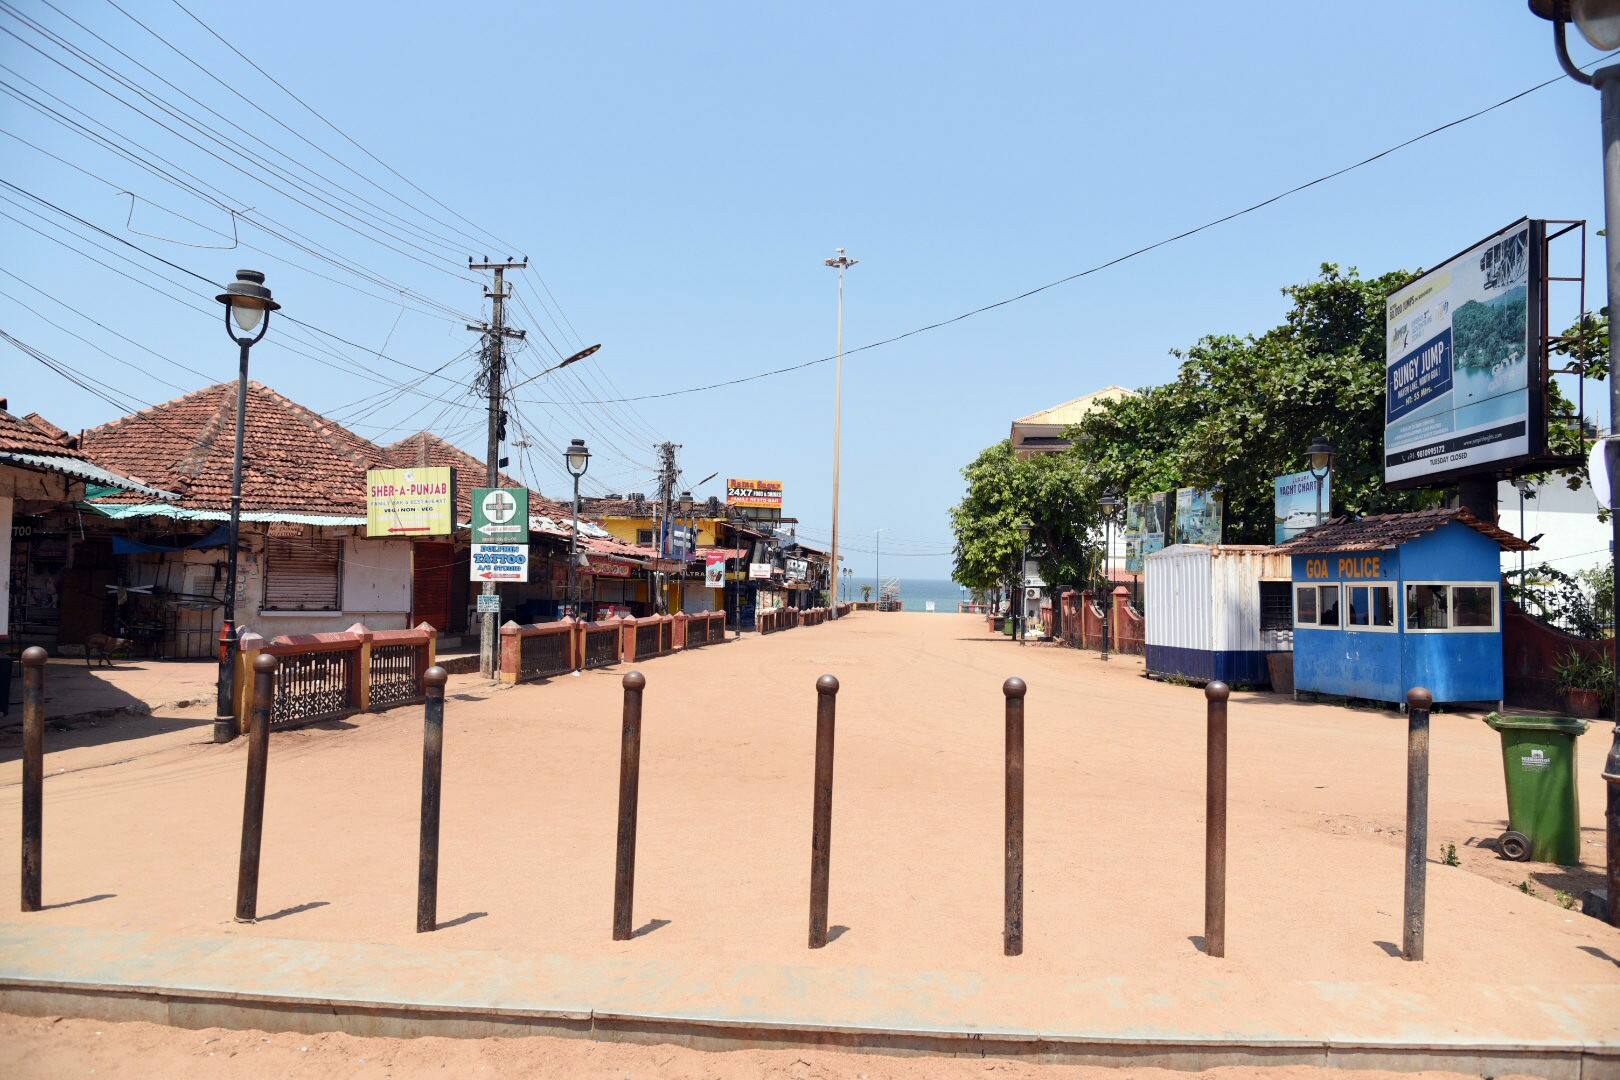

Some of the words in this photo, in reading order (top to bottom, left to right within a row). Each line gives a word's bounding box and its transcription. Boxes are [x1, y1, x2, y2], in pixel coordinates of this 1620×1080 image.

[1393, 356, 1419, 390] BUNGY
[1421, 341, 1444, 374] JUMP
[1430, 456, 1449, 465] TUESDAY
[1450, 452, 1468, 462] CLOSED
[371, 483, 447, 498] SHER-A-PUNJAB
[728, 488, 753, 496] 24X7
[1280, 485, 1296, 496] YACHT
[1298, 480, 1324, 494] CHARTR
[473, 554, 526, 564] TATTOO
[1306, 559, 1328, 578] GOA
[1338, 557, 1380, 578] POLICE
